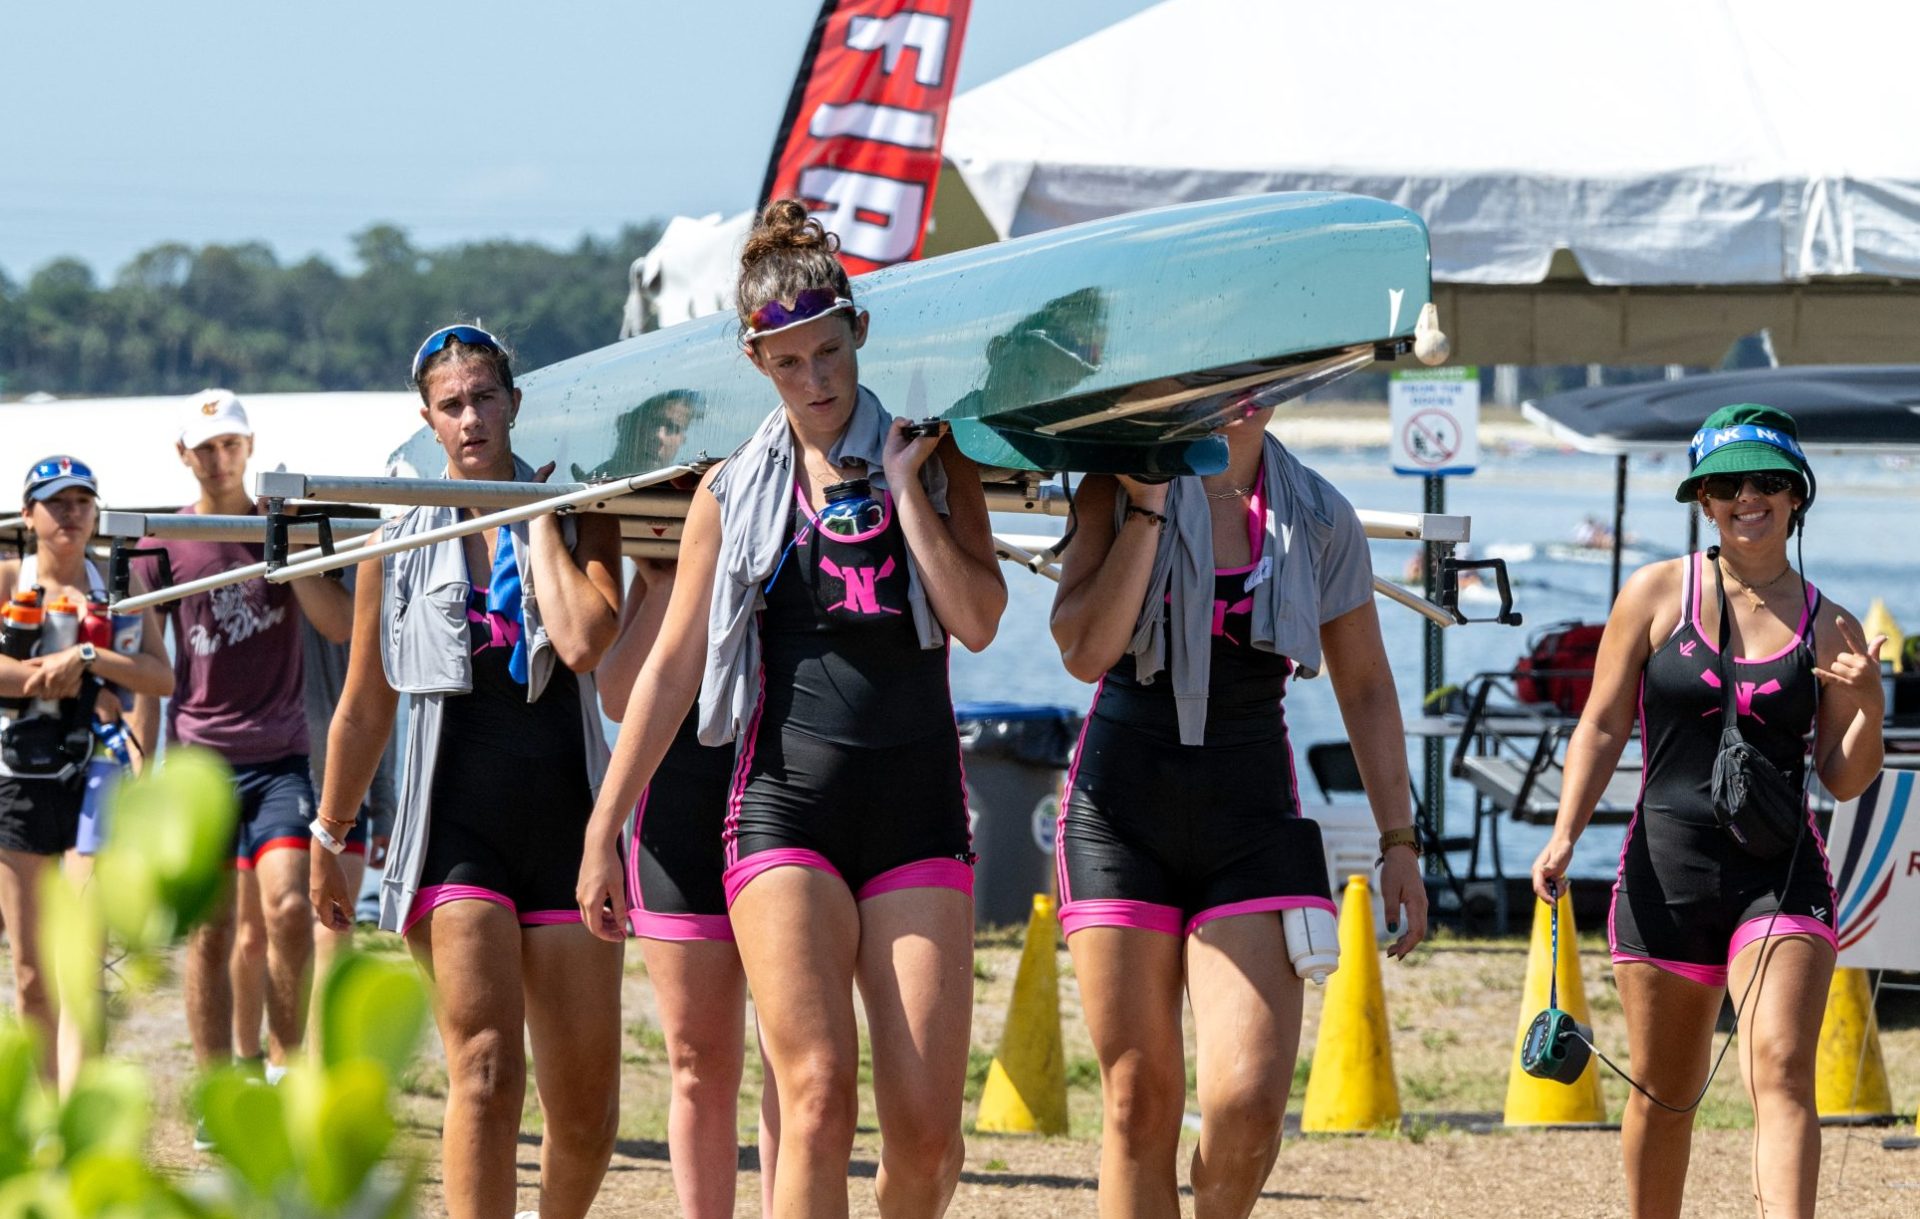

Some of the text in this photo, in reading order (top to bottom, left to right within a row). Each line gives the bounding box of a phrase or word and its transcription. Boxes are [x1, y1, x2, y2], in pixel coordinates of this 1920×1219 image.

[1714, 428, 1740, 447] NK
[1755, 428, 1781, 444] NK
[841, 566, 881, 614] N
